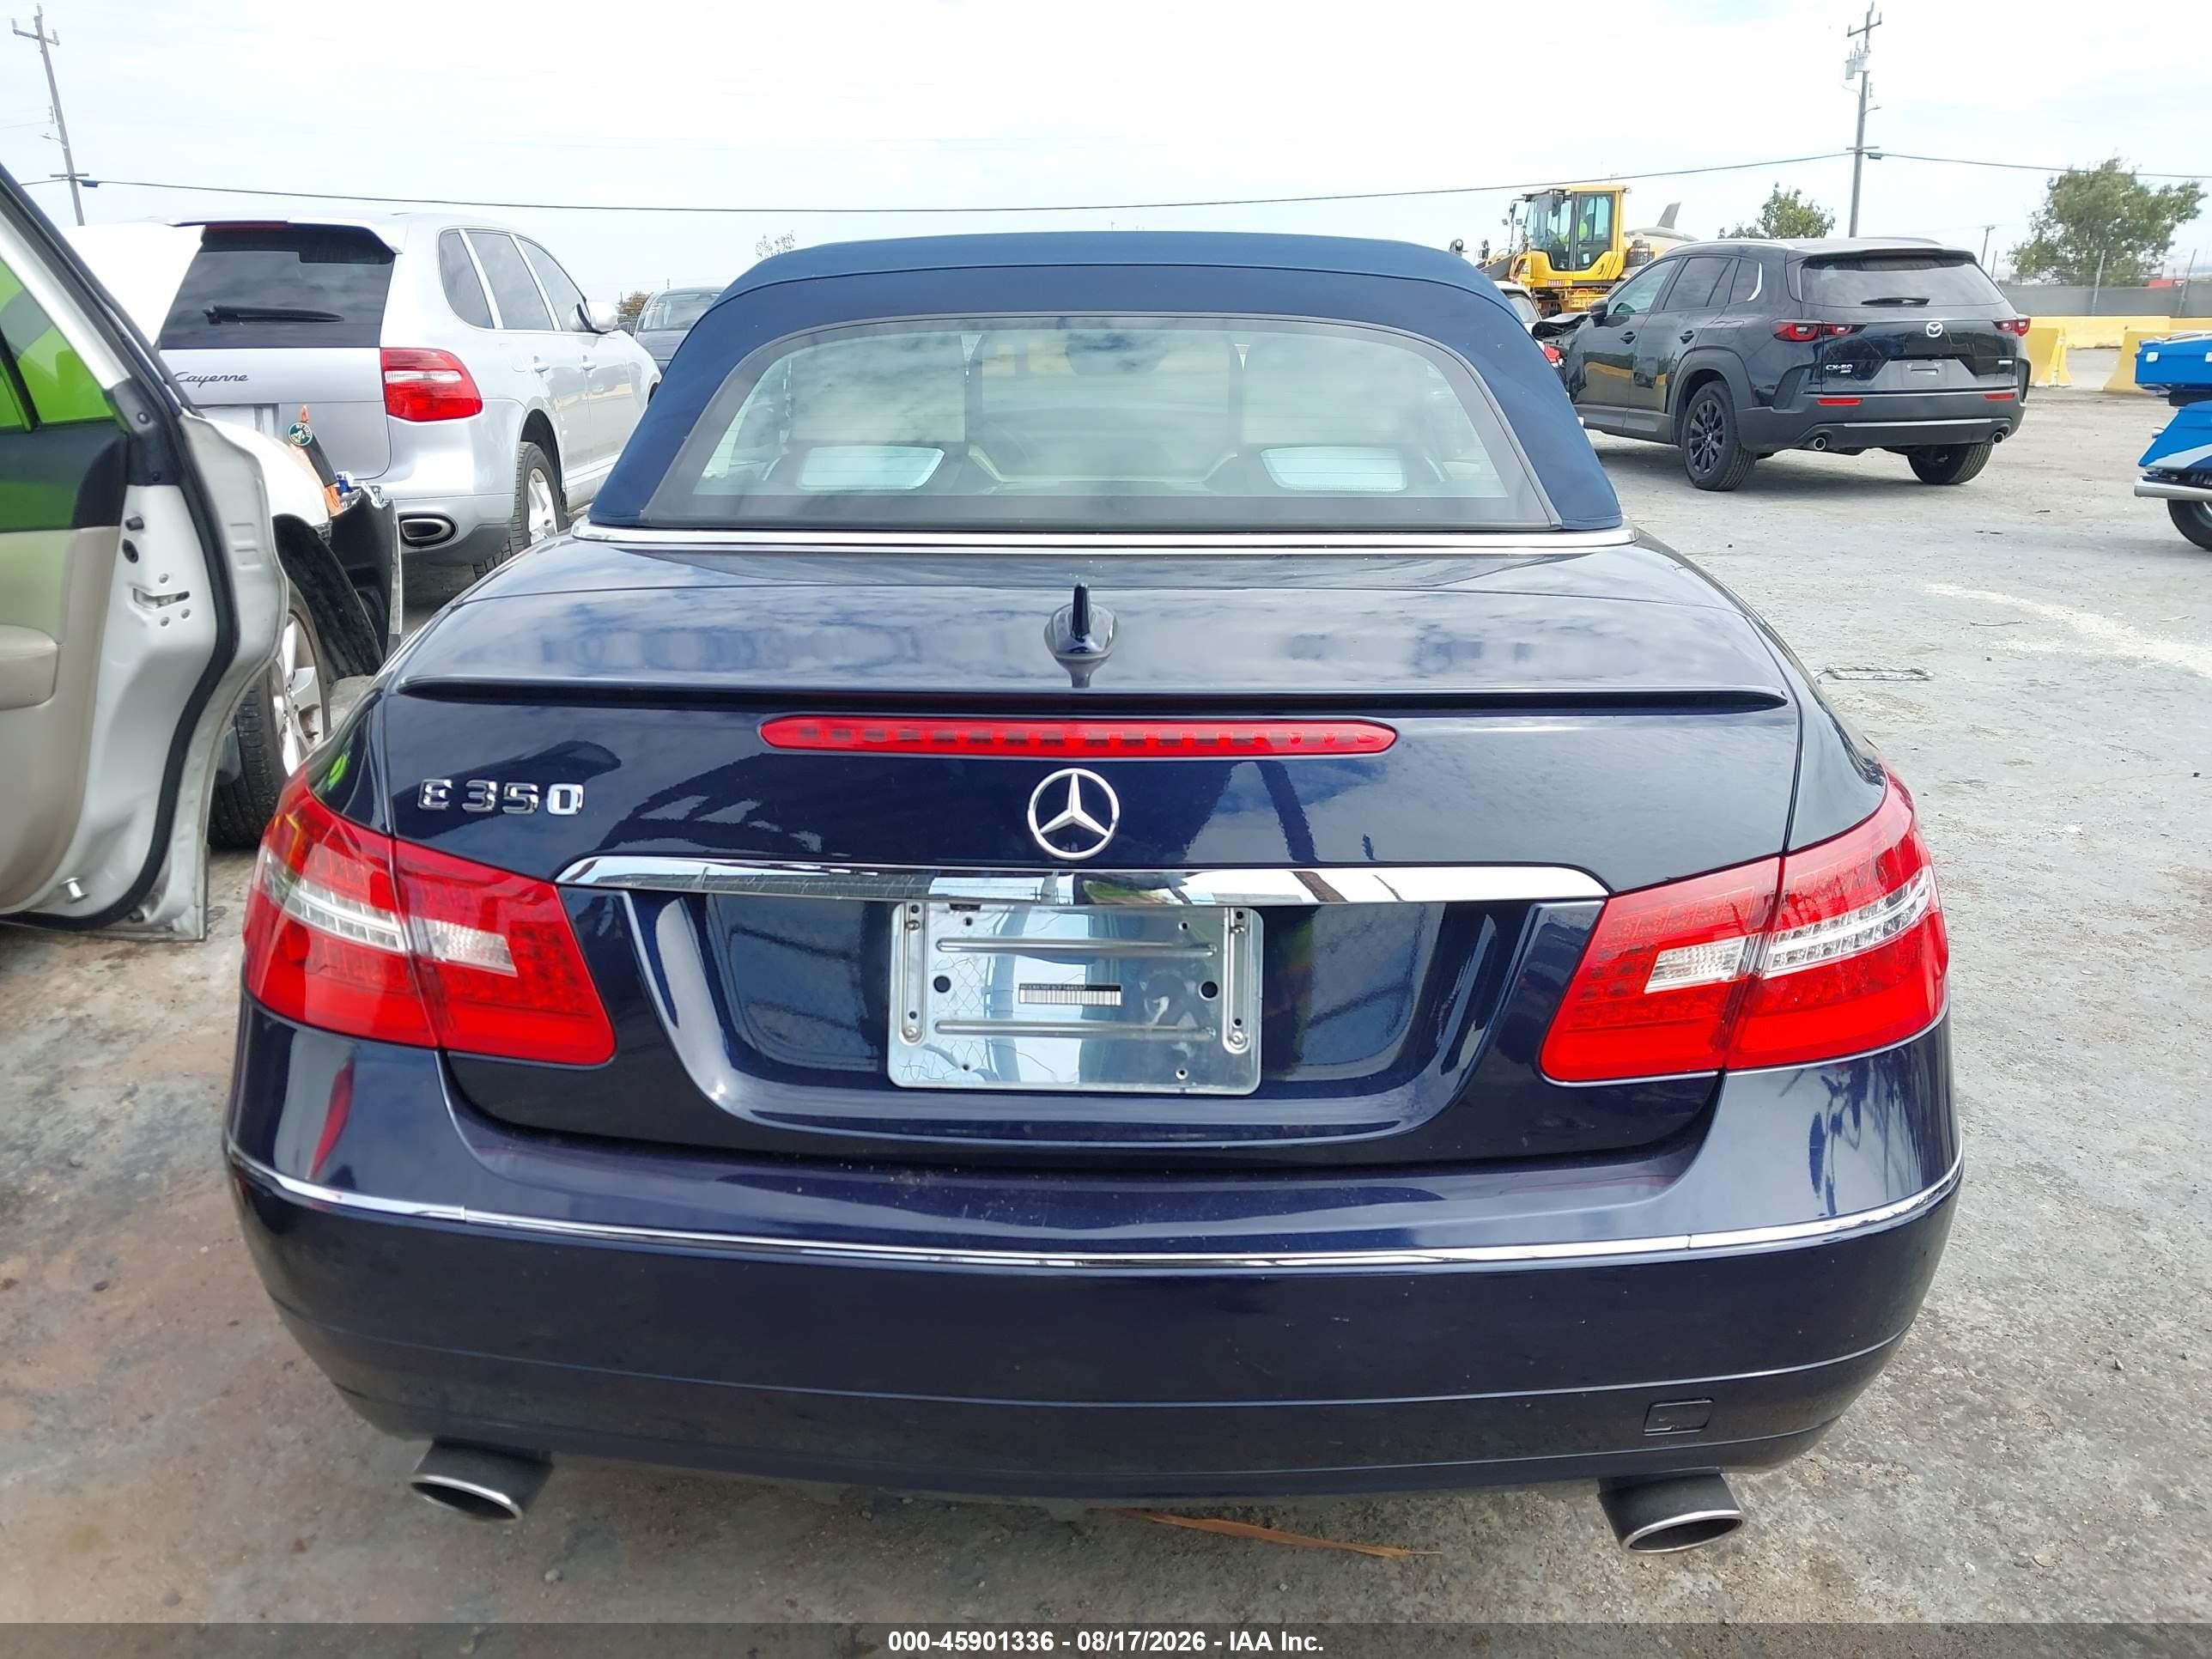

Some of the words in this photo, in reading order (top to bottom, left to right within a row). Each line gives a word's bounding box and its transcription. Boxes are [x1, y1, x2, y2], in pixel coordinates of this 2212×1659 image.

[173, 371, 248, 388] Cayenne
[417, 778, 453, 811] E
[462, 779, 584, 816] 350
